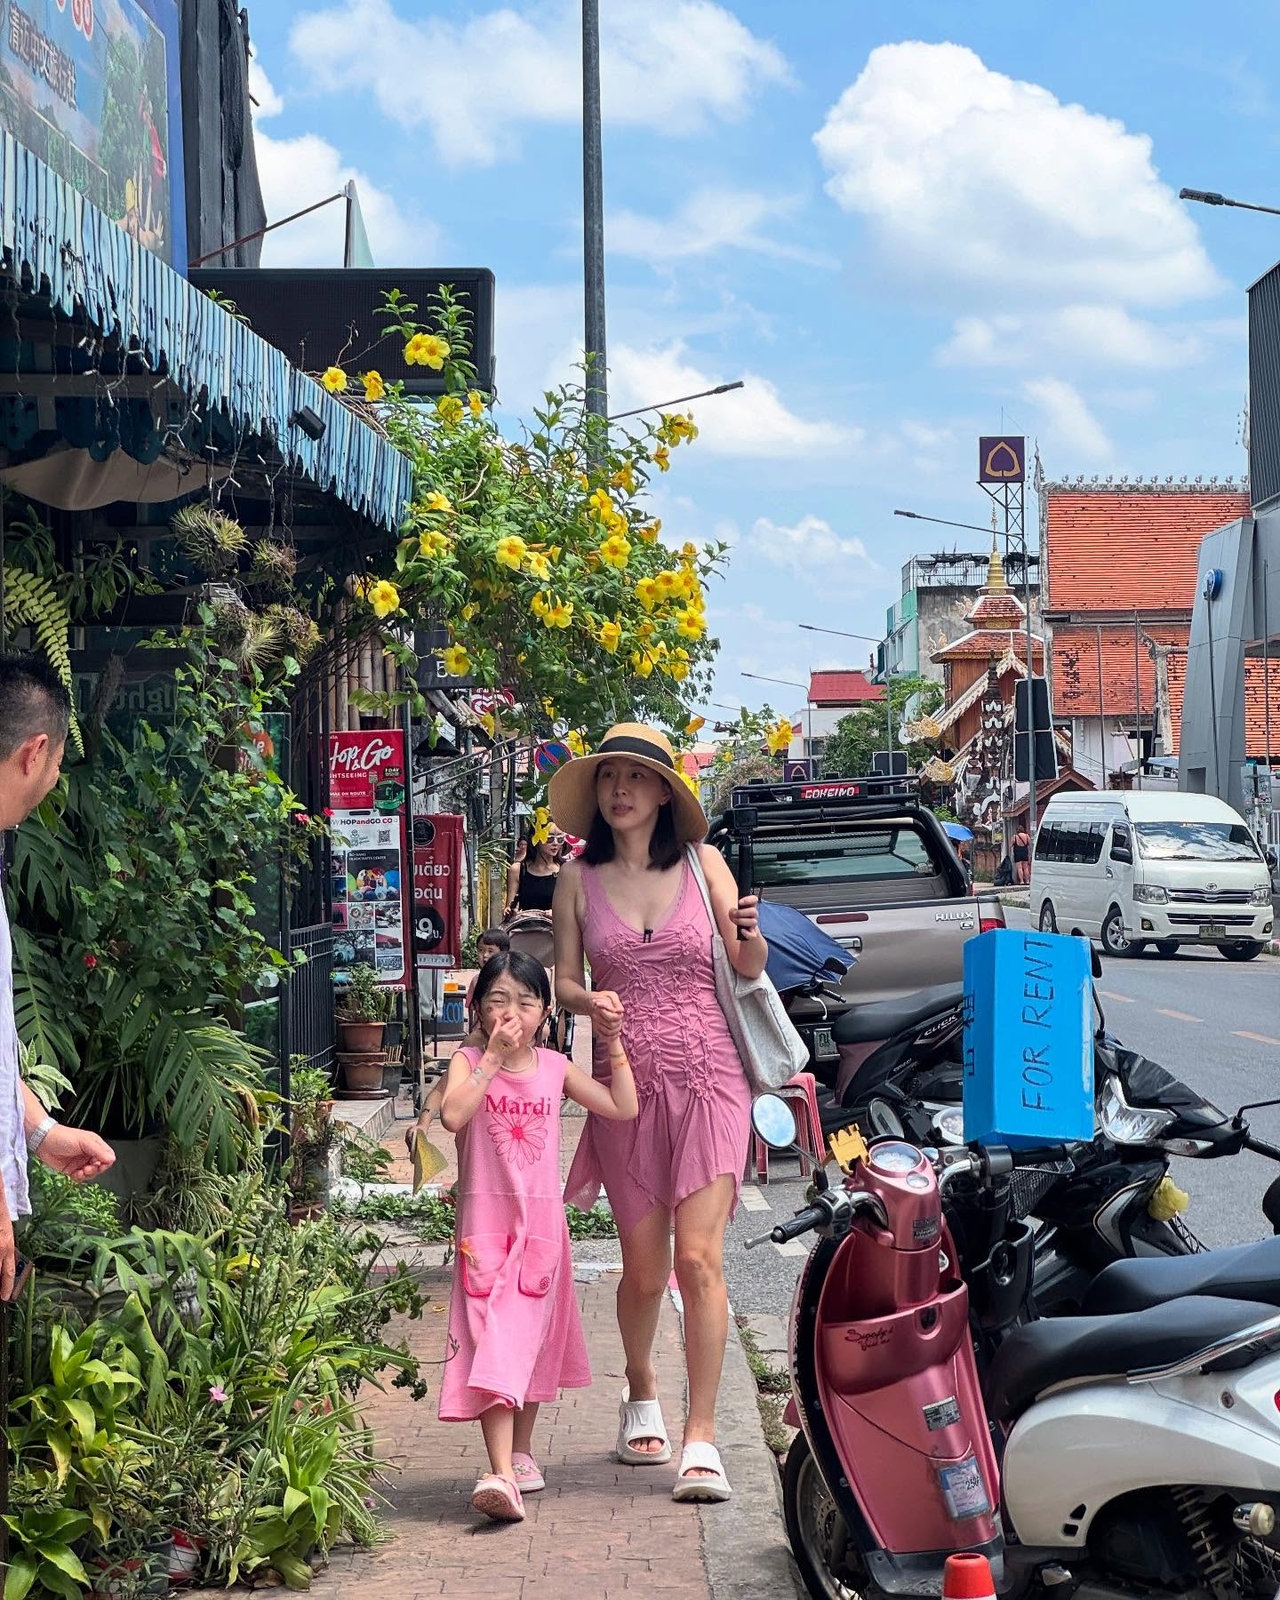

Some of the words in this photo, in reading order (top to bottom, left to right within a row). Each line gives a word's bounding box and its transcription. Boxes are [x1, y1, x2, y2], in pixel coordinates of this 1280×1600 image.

[361, 738, 395, 770] Go
[1022, 933, 1055, 1029] RENT
[1022, 1045, 1055, 1111] FOR
[484, 1093, 552, 1116] Mardi
